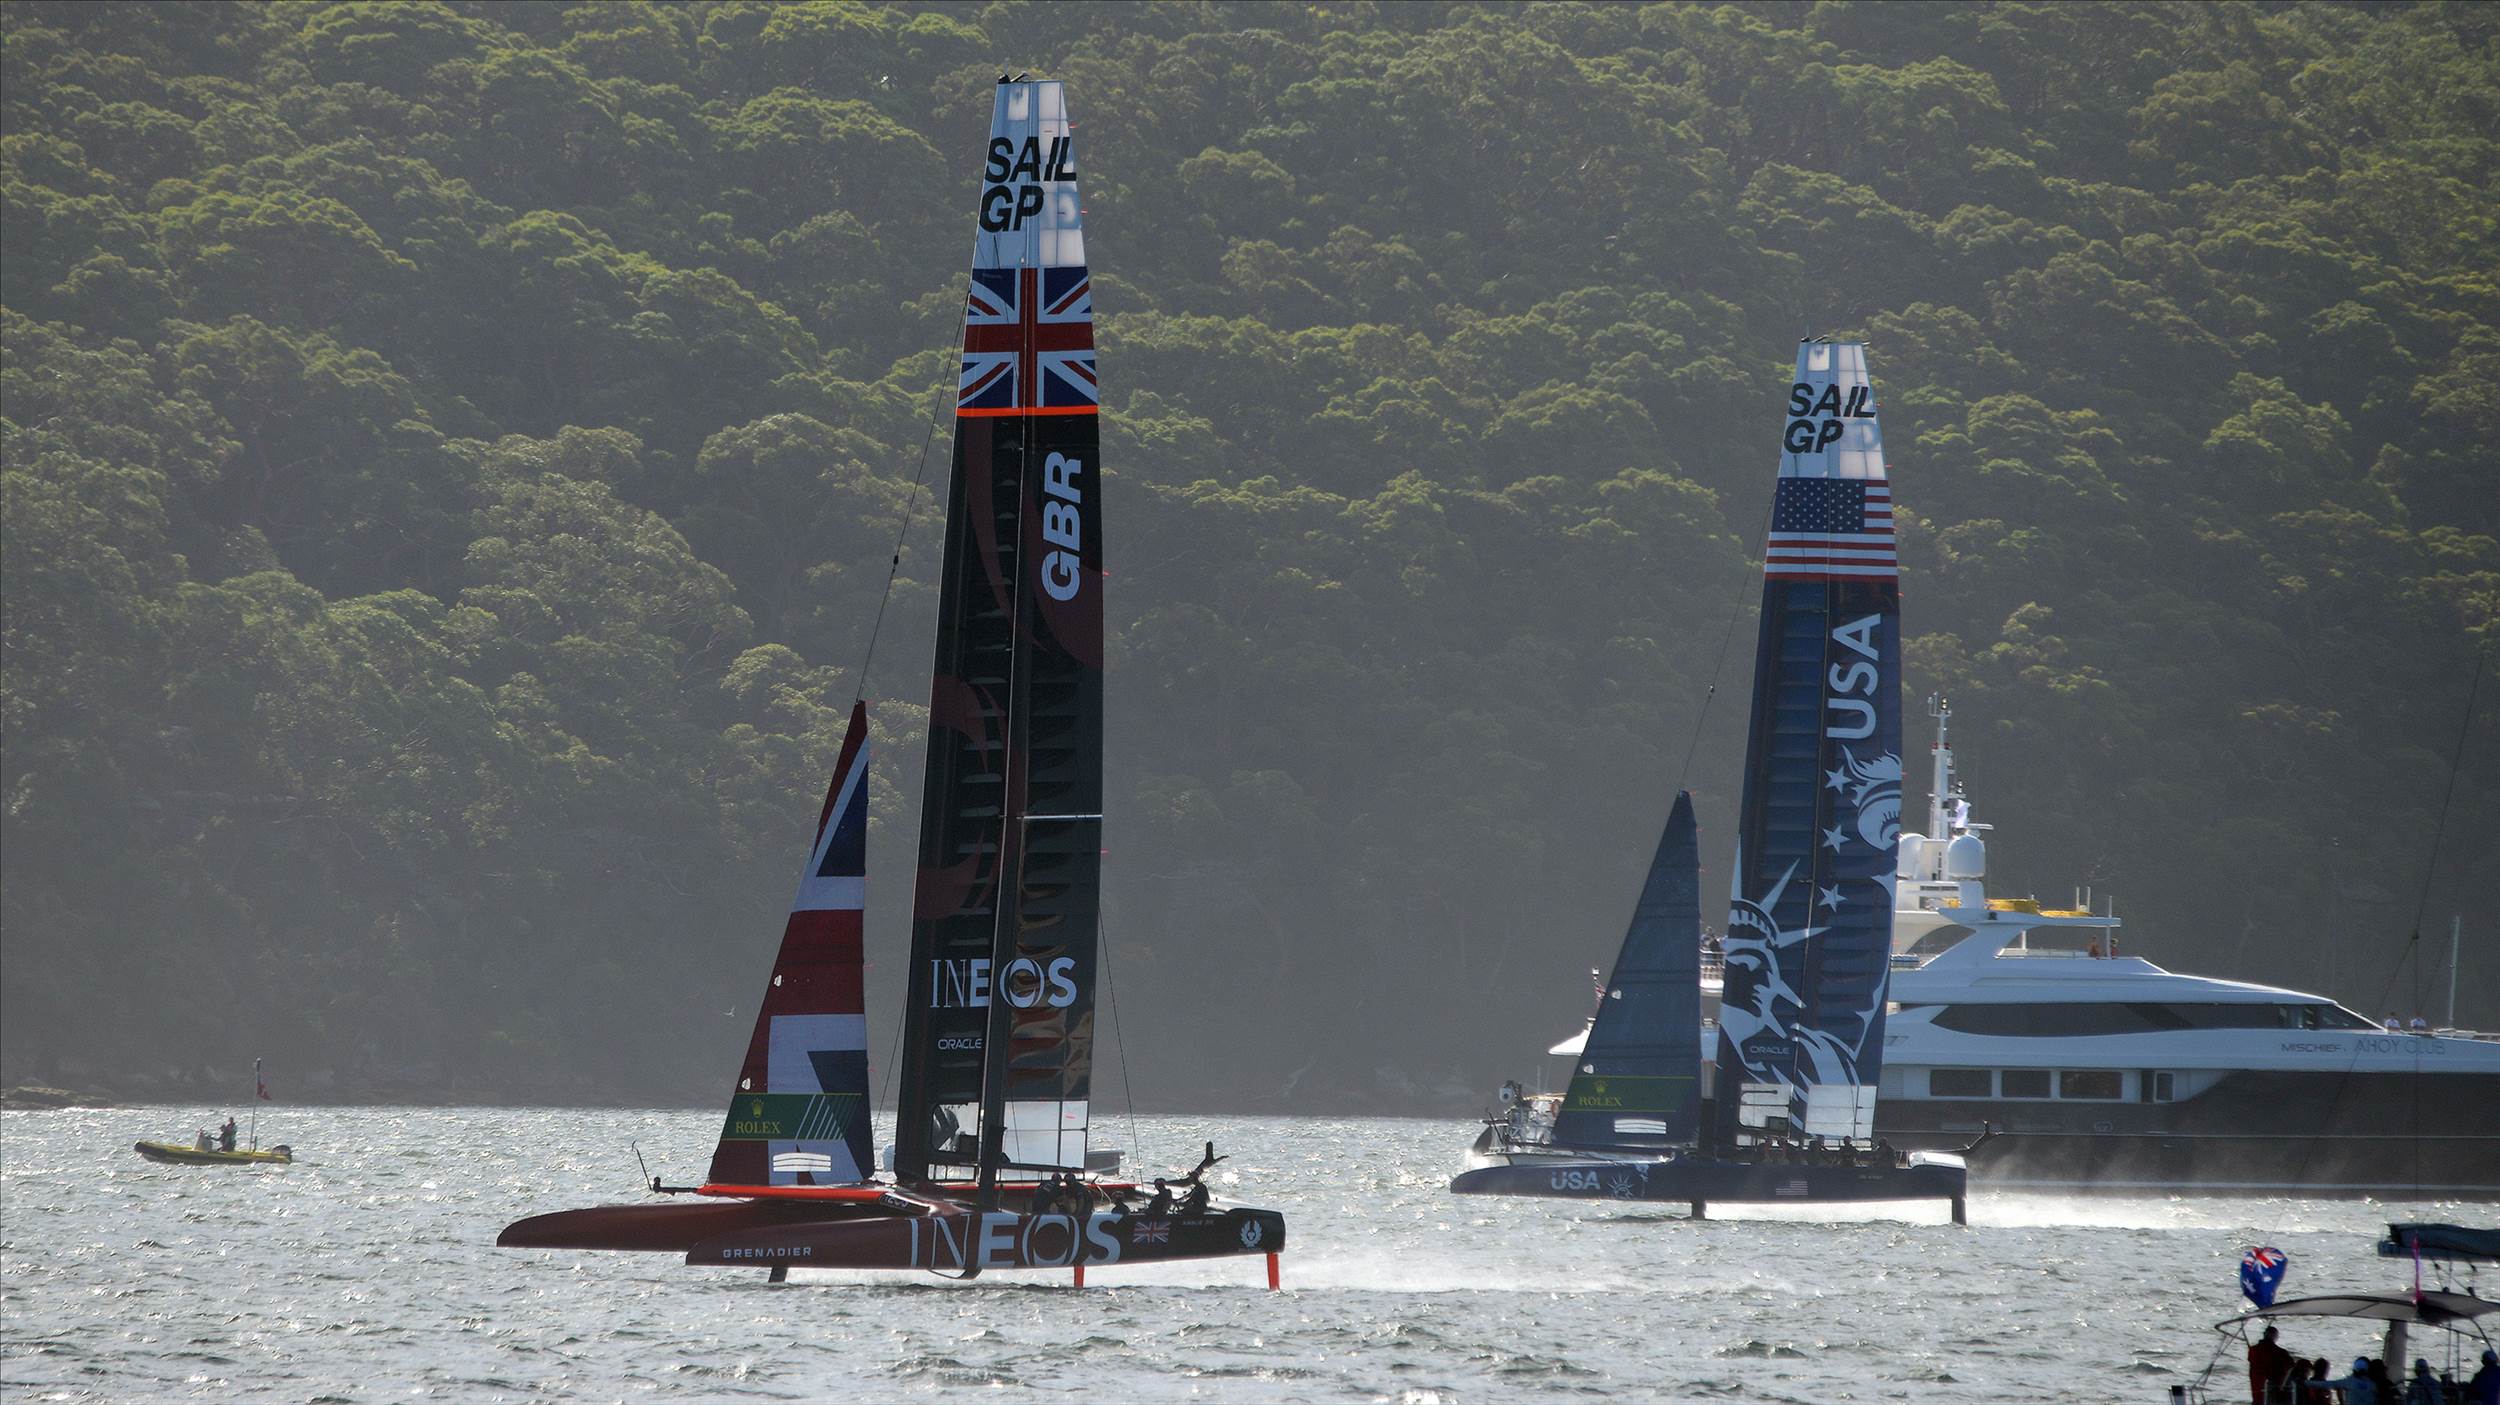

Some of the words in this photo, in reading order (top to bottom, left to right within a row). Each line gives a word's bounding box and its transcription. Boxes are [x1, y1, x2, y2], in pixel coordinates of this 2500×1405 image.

[984, 136, 1077, 183] SAIL
[978, 185, 1044, 232] GP
[1788, 382, 1876, 418] SAIL
[1783, 419, 1844, 454] GP
[1041, 451, 1082, 601] GBR
[1826, 613, 1881, 739] USA
[930, 957, 1077, 1009] INEOS
[937, 1038, 983, 1050] ORACLE
[1750, 1045, 1792, 1055] ORACLE
[2354, 1038, 2401, 1054] AHOY
[2404, 1039, 2446, 1055] CLUB
[1579, 1096, 1622, 1106] ROLEX
[735, 1121, 781, 1134] ROLEX
[1551, 1170, 1601, 1190] USA
[722, 1247, 812, 1259] GRENADIER
[905, 1212, 1124, 1269] INEOS
